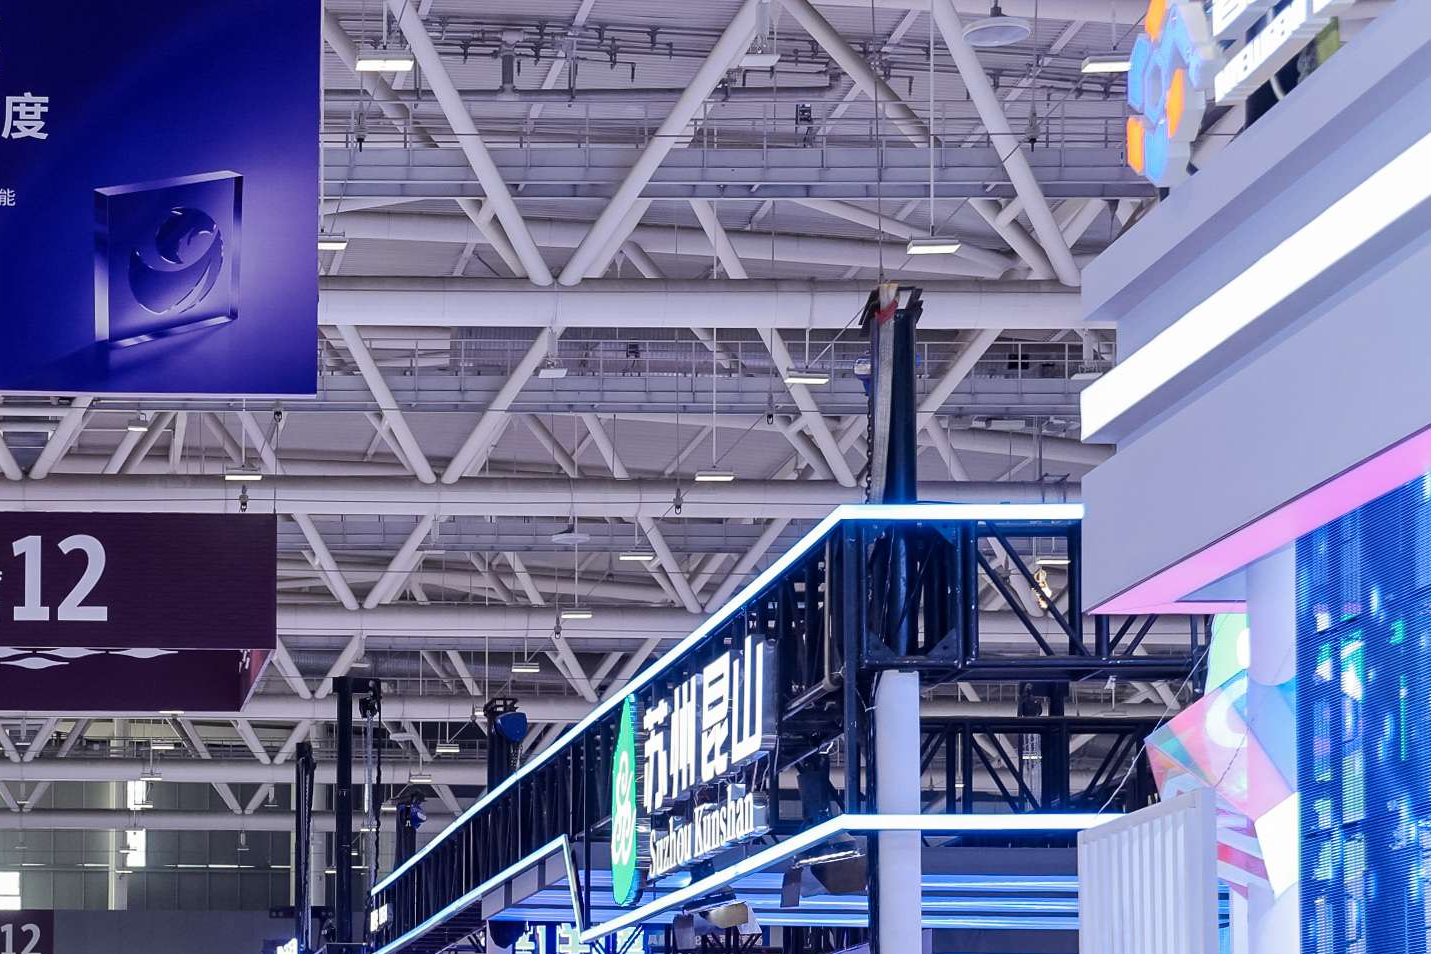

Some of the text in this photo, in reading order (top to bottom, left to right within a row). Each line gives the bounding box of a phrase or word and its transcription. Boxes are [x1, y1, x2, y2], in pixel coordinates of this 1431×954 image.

[11, 533, 108, 622] 12
[643, 634, 764, 815] 苏州昆山
[649, 784, 755, 880] Suzhou Kunshan
